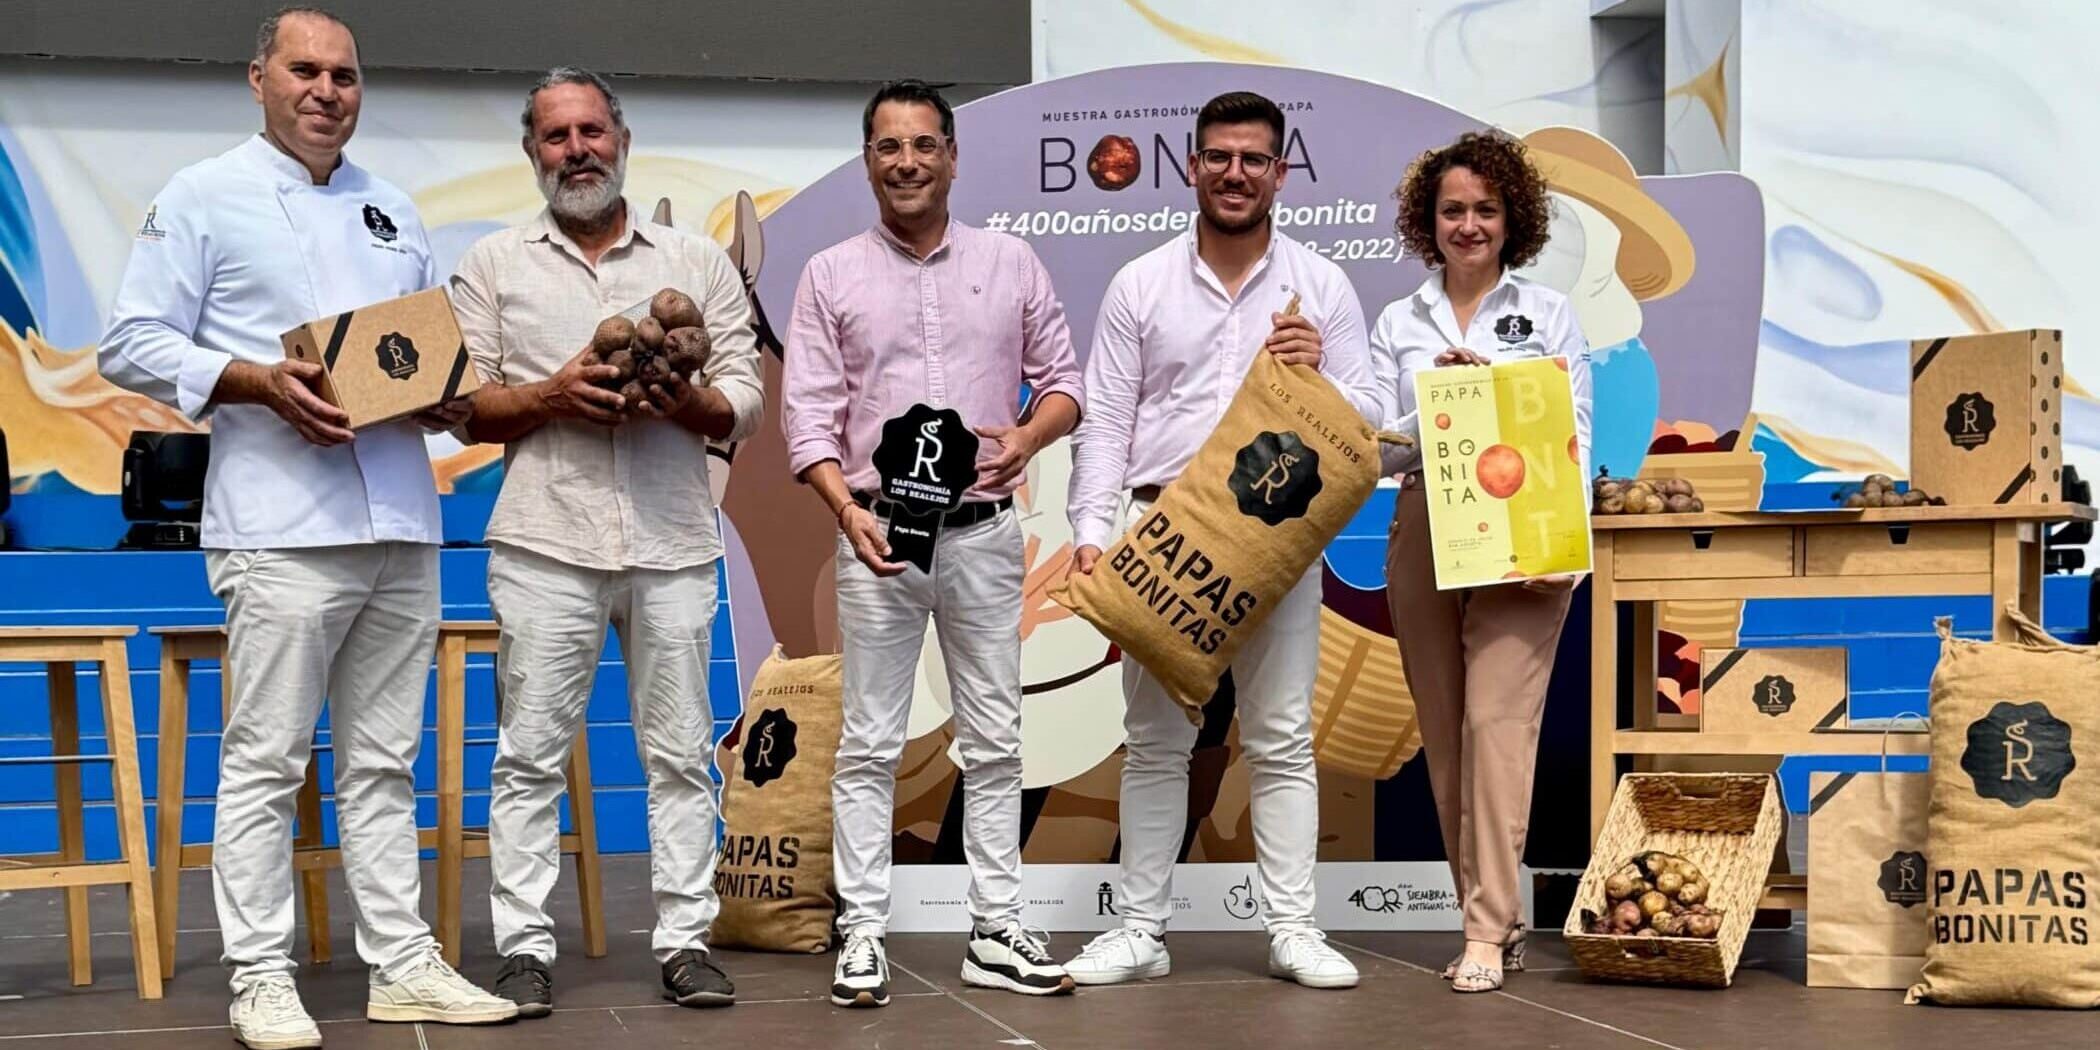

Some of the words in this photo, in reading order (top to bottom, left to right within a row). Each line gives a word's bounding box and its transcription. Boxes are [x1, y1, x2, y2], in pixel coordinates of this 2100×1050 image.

[1042, 111, 1108, 123] MUESTRA
[1114, 103, 1199, 120] GASTRONÓM
[1430, 386, 1482, 404] PAPA
[1270, 383, 1293, 404] LOS
[1297, 406, 1361, 463] REALEJOS
[890, 487, 906, 496] LOS
[909, 489, 950, 505] REALEJOS
[891, 478, 951, 496] GASTRONOMÍA
[1136, 511, 1257, 626] PAPAS
[1110, 543, 1227, 655] BONITAS
[1407, 890, 1447, 901] SIEMBRA
[1934, 868, 2087, 909] PAPAS
[1935, 914, 2088, 946] BONITAS
